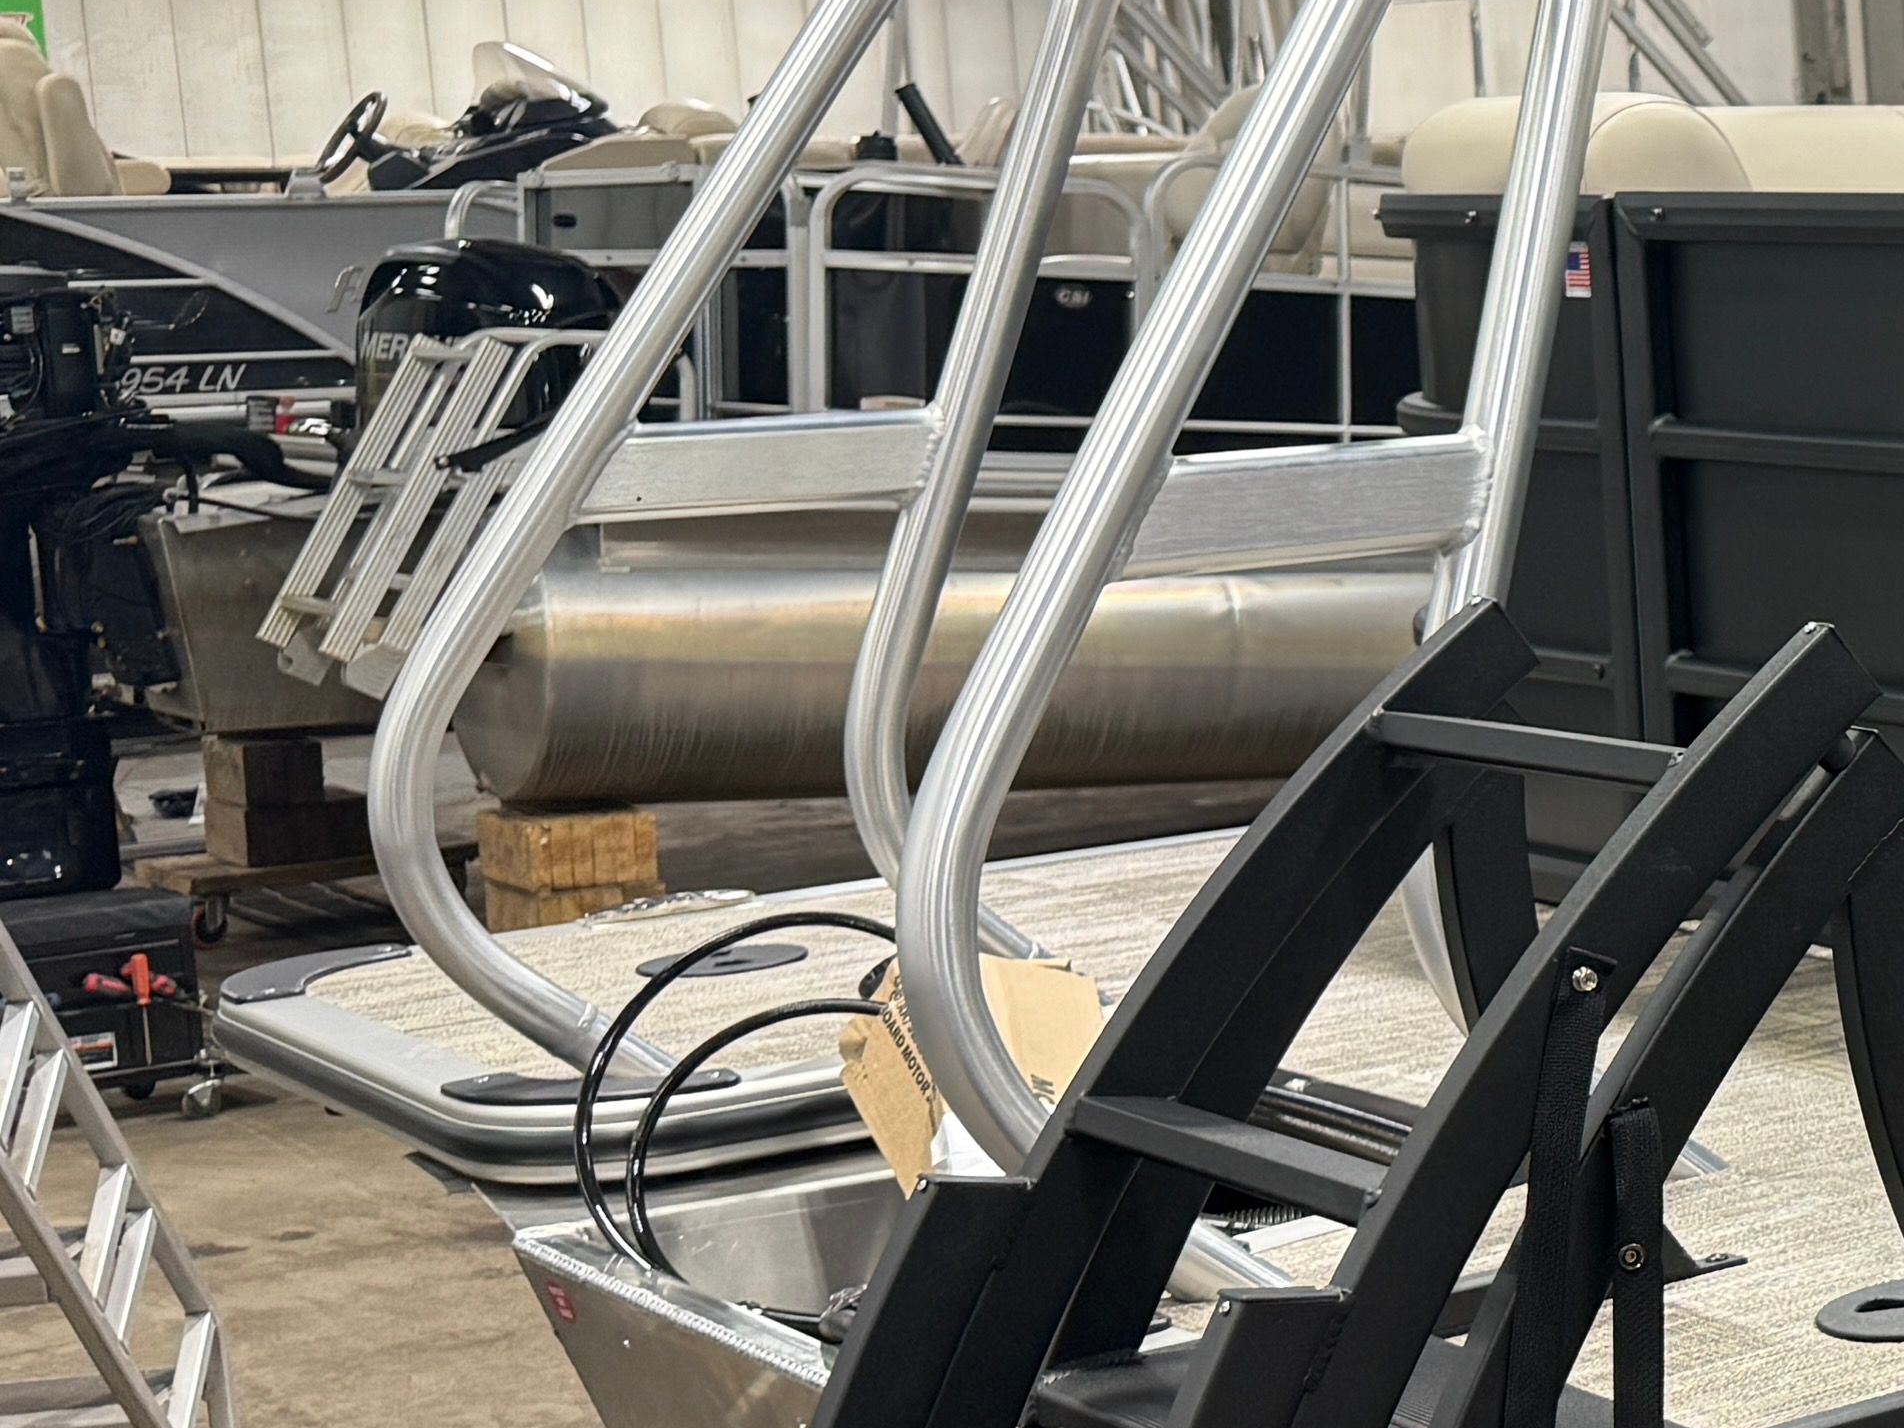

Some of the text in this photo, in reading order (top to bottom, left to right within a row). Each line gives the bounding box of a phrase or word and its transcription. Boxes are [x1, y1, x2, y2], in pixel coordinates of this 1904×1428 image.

[197, 363, 247, 392] LN
[881, 1006, 906, 1048] OARD
[900, 1043, 931, 1095] MOTOR
